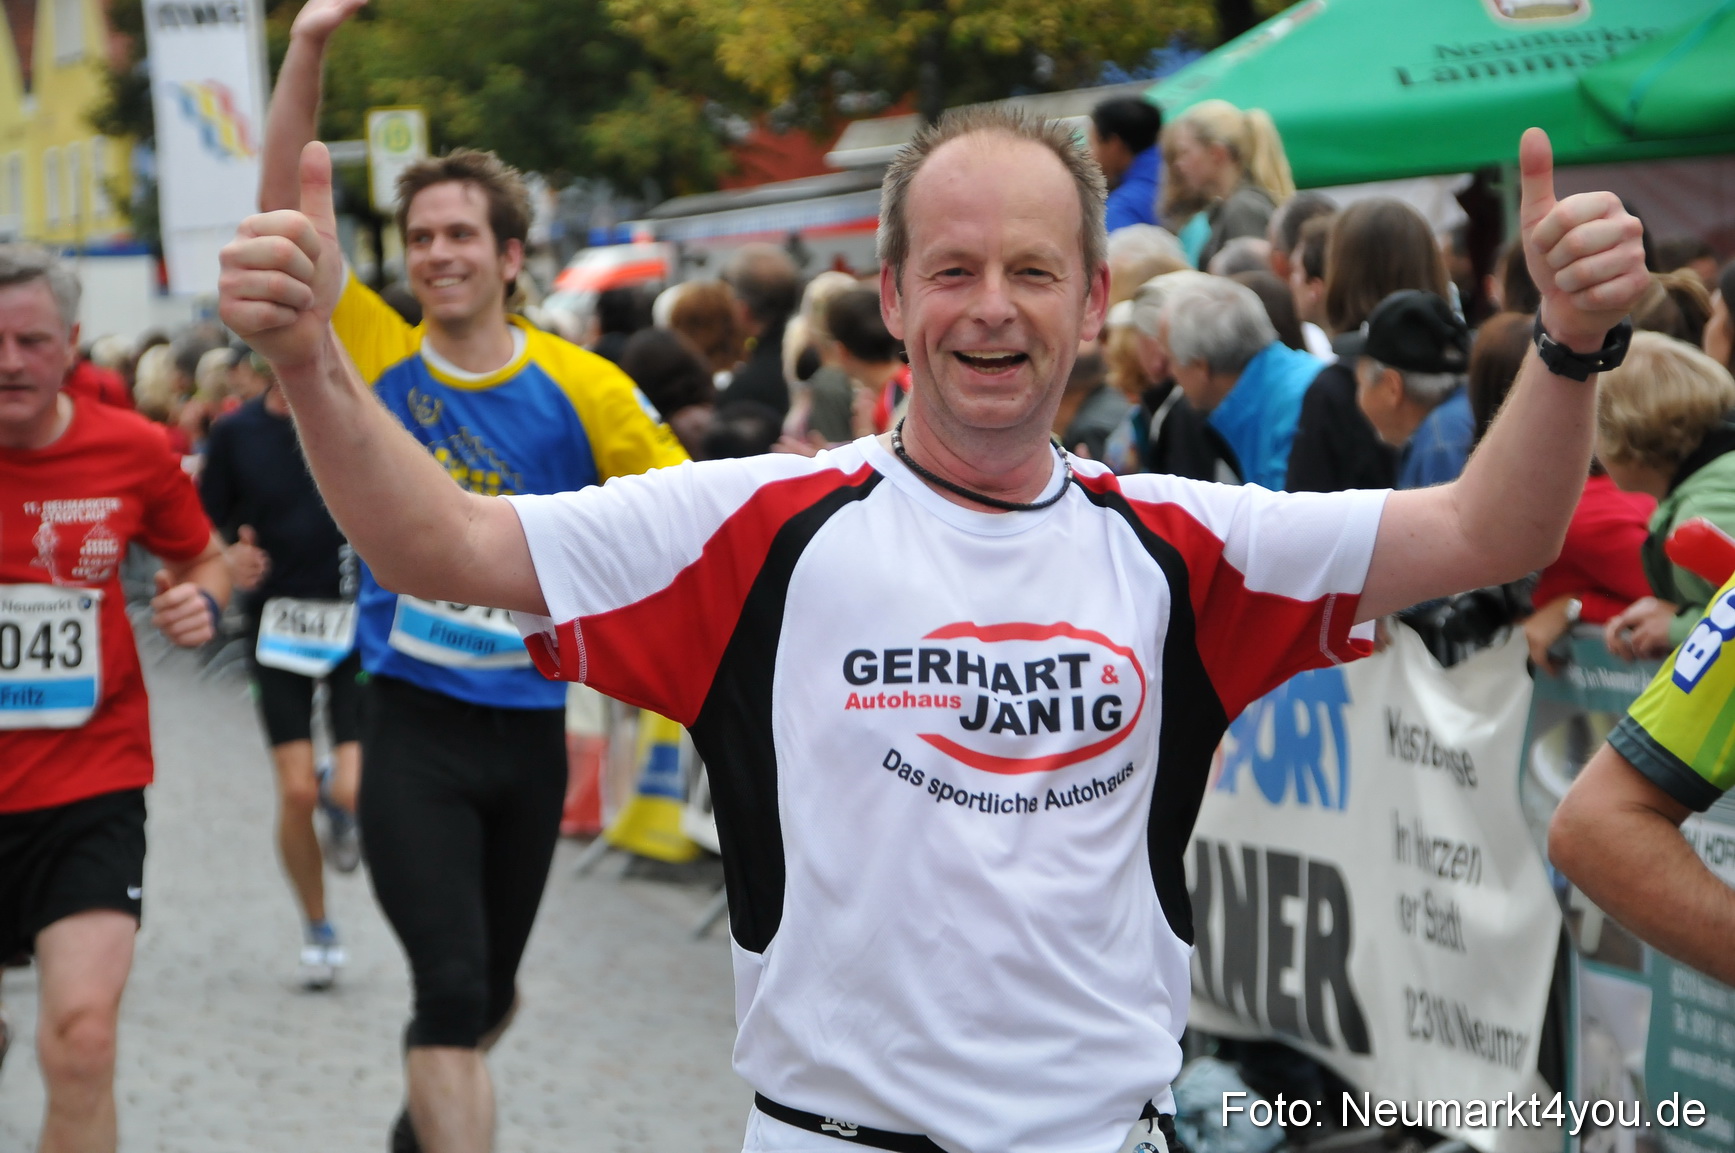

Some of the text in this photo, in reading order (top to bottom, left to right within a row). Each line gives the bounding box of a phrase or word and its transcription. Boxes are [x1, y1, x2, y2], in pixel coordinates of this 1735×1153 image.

[1, 600, 72, 614] Neumarkt
[429, 620, 496, 654] Florian
[842, 647, 1120, 696] GERHART &
[1, 685, 45, 706] Fritz
[844, 690, 962, 711] Autohaus
[959, 693, 1123, 736] JÄNIG
[882, 748, 1134, 815] Das sportliche Autohaus
